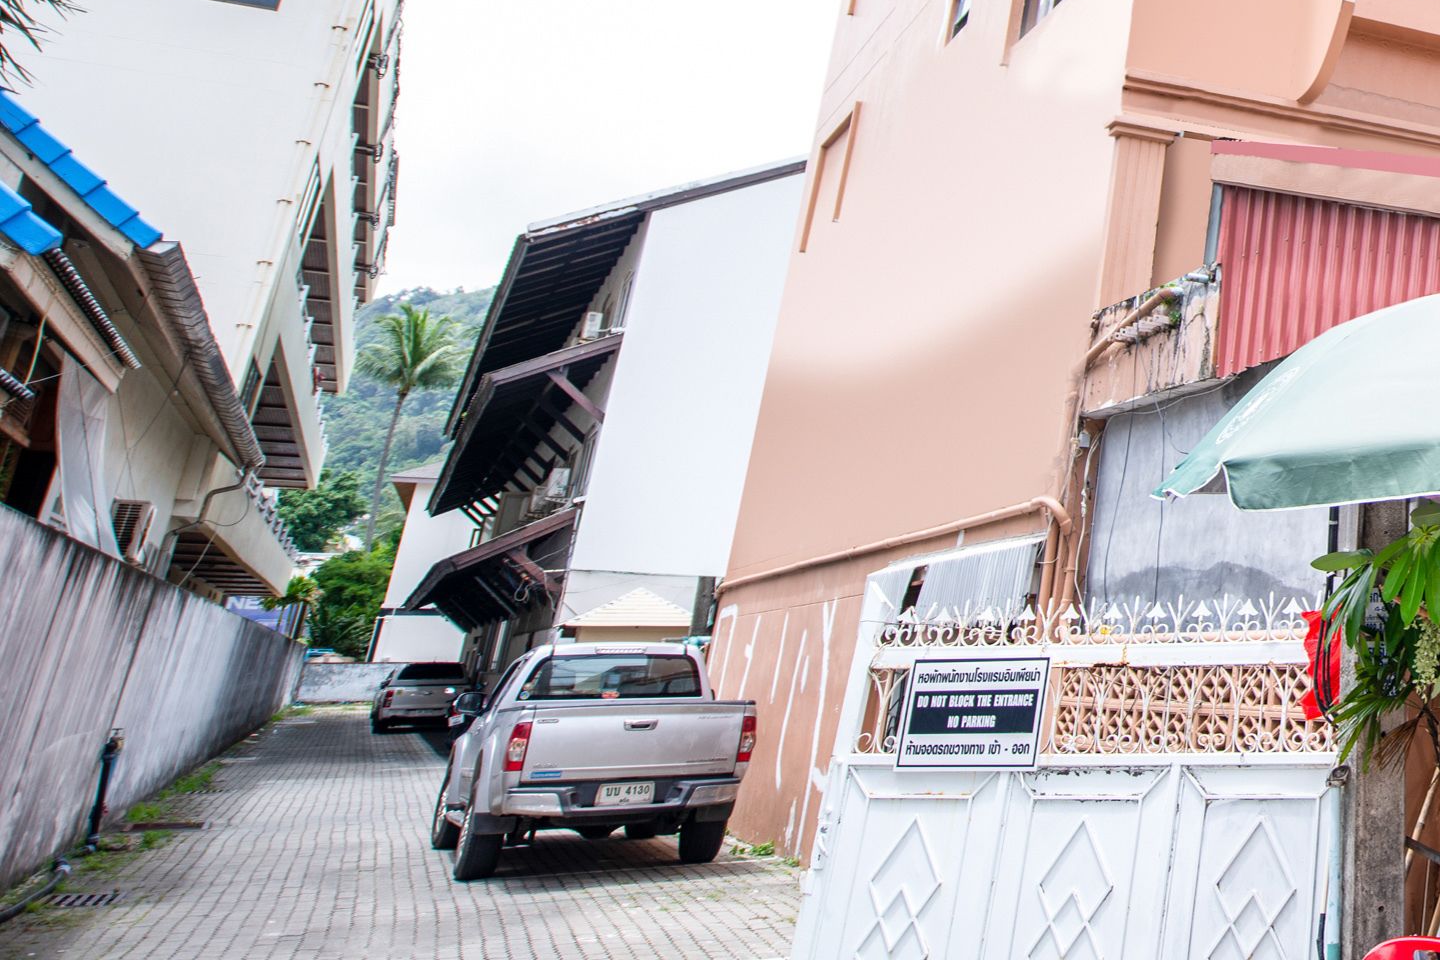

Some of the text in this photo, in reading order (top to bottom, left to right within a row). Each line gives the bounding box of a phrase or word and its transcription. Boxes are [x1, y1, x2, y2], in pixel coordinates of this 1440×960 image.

[917, 693, 1034, 708] DO NOT BLOCK THE ENTRANCE
[947, 715, 996, 728] NO PARKING
[1012, 743, 1030, 755] ออก
[625, 784, 650, 796] 4130
